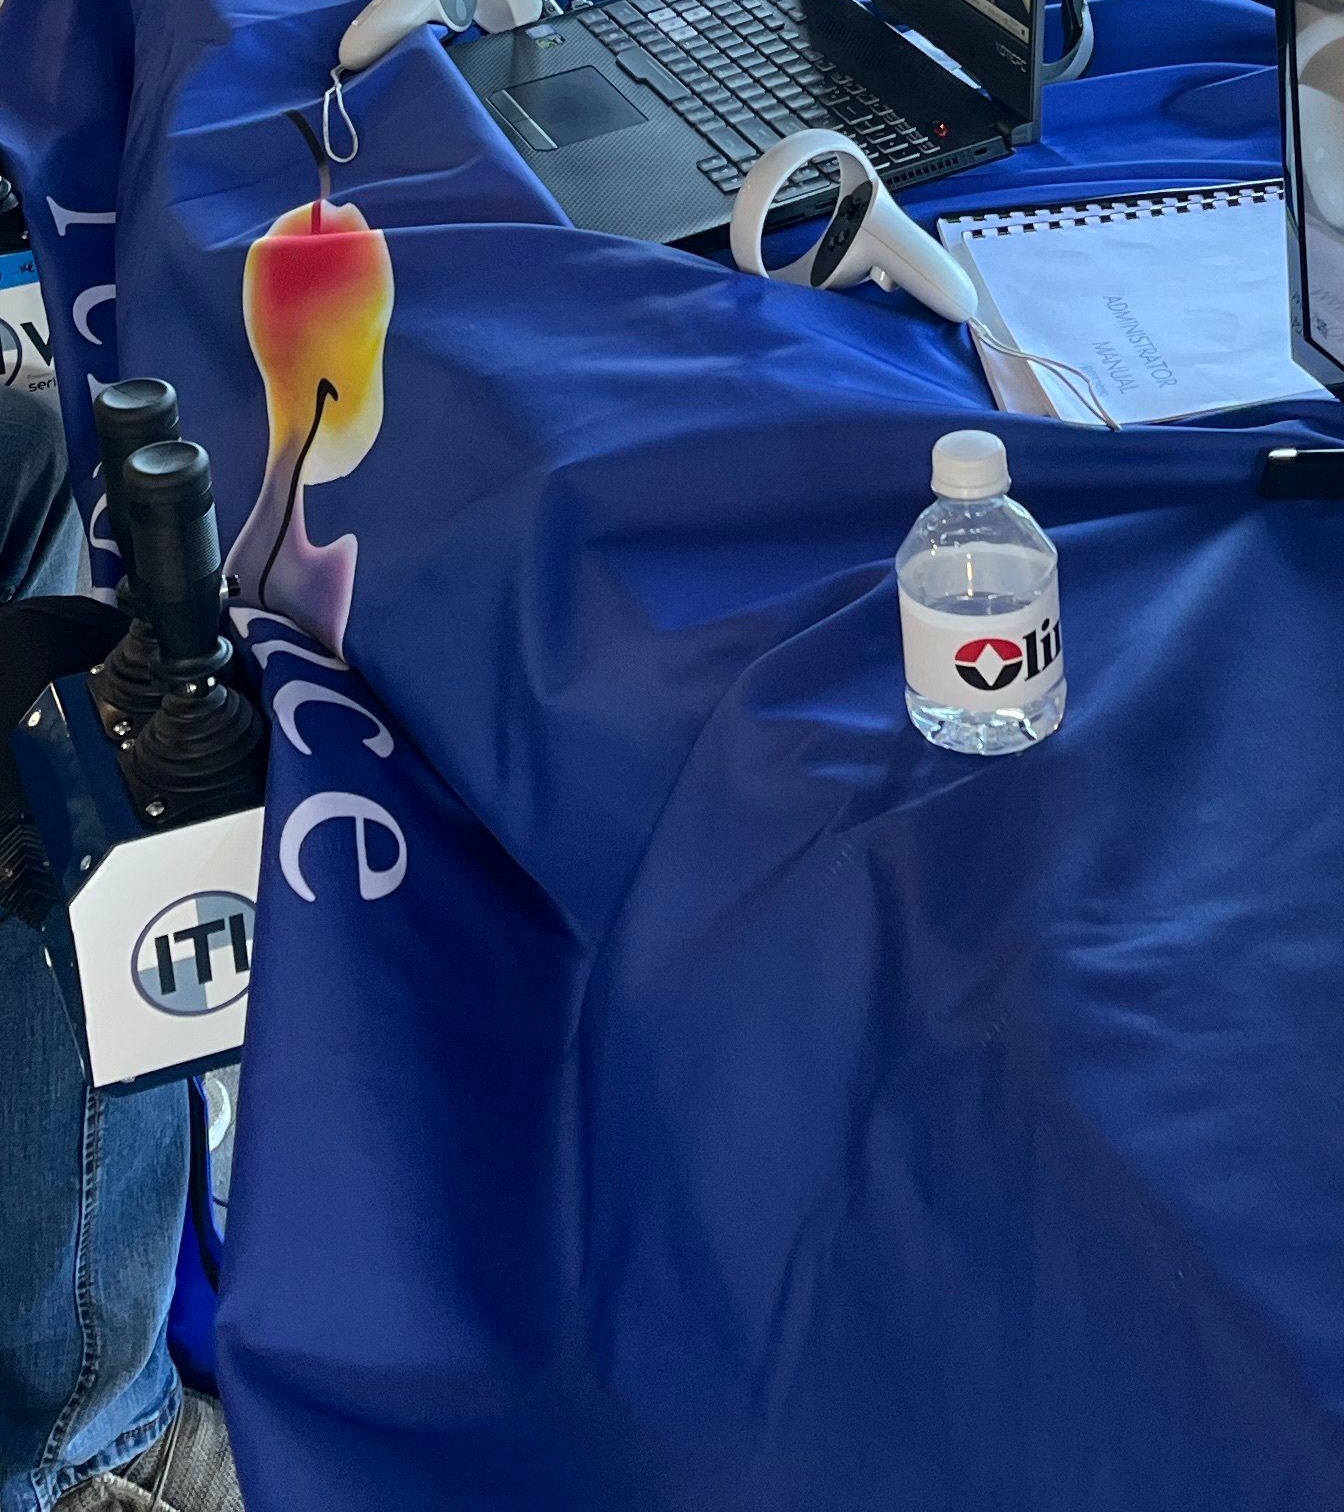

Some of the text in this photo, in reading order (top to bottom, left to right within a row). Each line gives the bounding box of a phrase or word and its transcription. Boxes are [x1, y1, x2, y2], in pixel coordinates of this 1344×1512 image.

[1092, 341, 1140, 395] MANUAL
[1102, 295, 1178, 389] ADMINISTRATOR
[29, 378, 57, 393] seri
[154, 913, 250, 995] ITI
